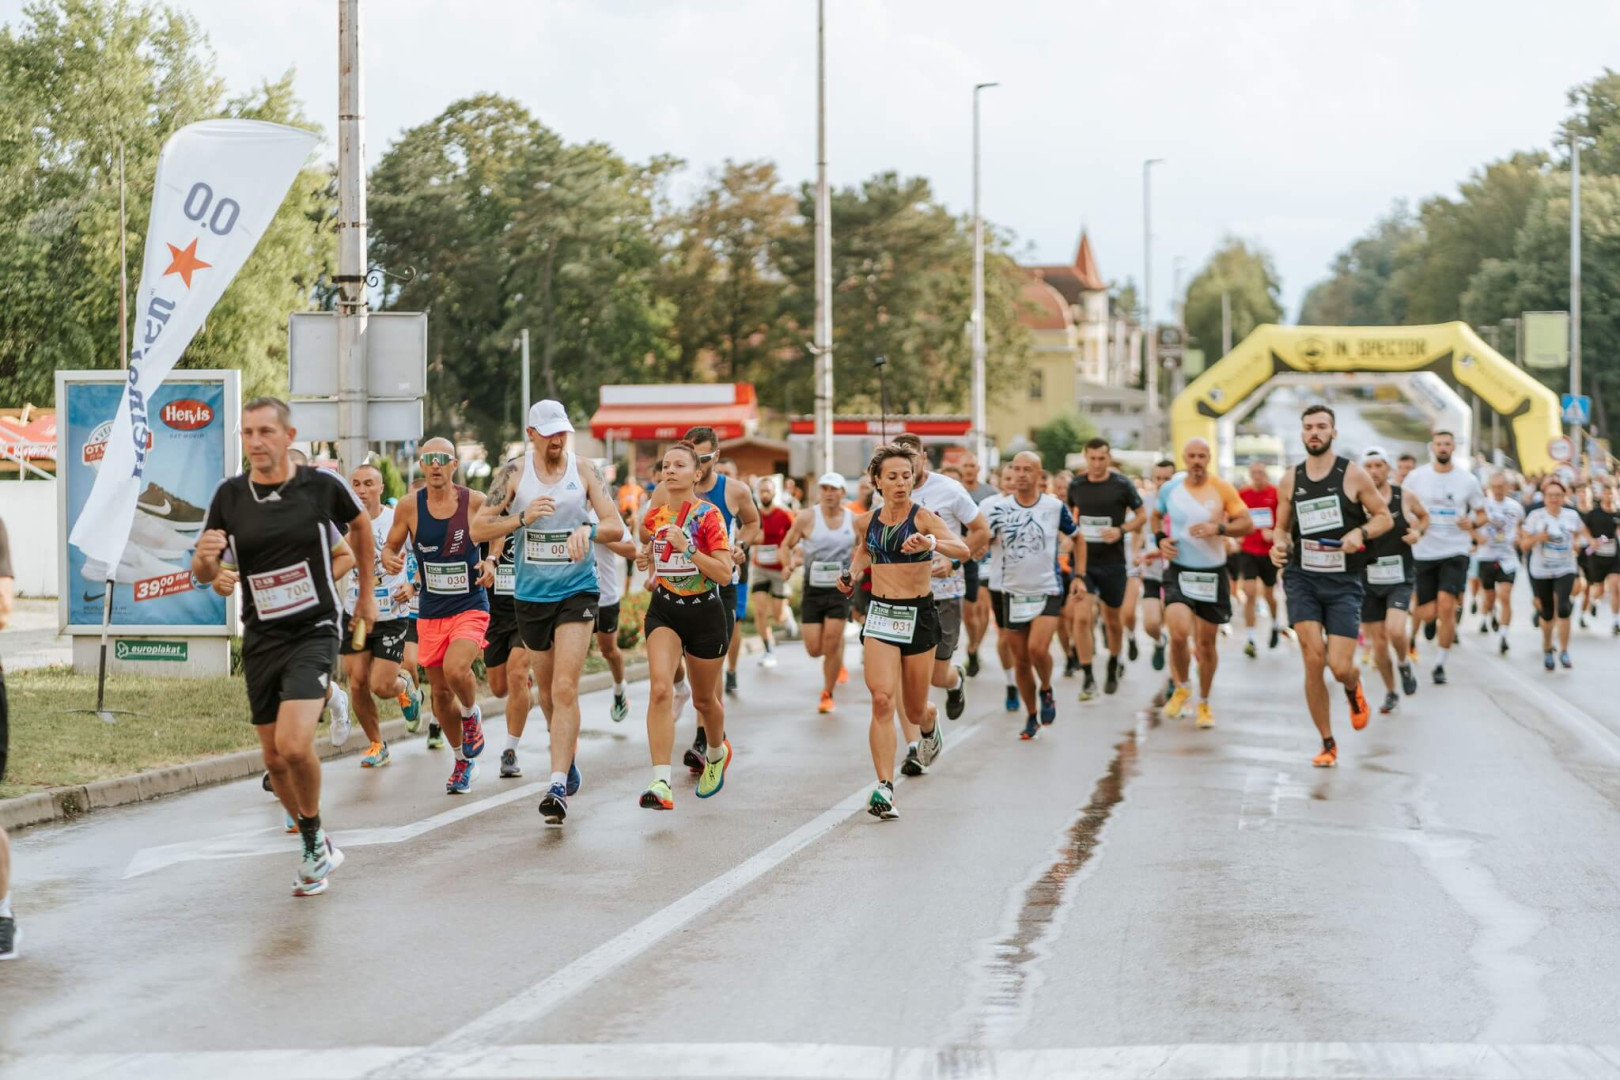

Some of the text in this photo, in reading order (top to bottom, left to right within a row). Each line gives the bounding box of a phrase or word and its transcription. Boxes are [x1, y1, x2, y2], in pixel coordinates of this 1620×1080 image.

[183, 182, 240, 236] 0.0
[166, 405, 211, 424] Hervis
[551, 544, 569, 555] 00
[673, 555, 692, 565] 71
[447, 575, 466, 585] 030
[284, 581, 311, 599] 700
[892, 620, 911, 632] 031
[131, 644, 181, 655] europlakat
